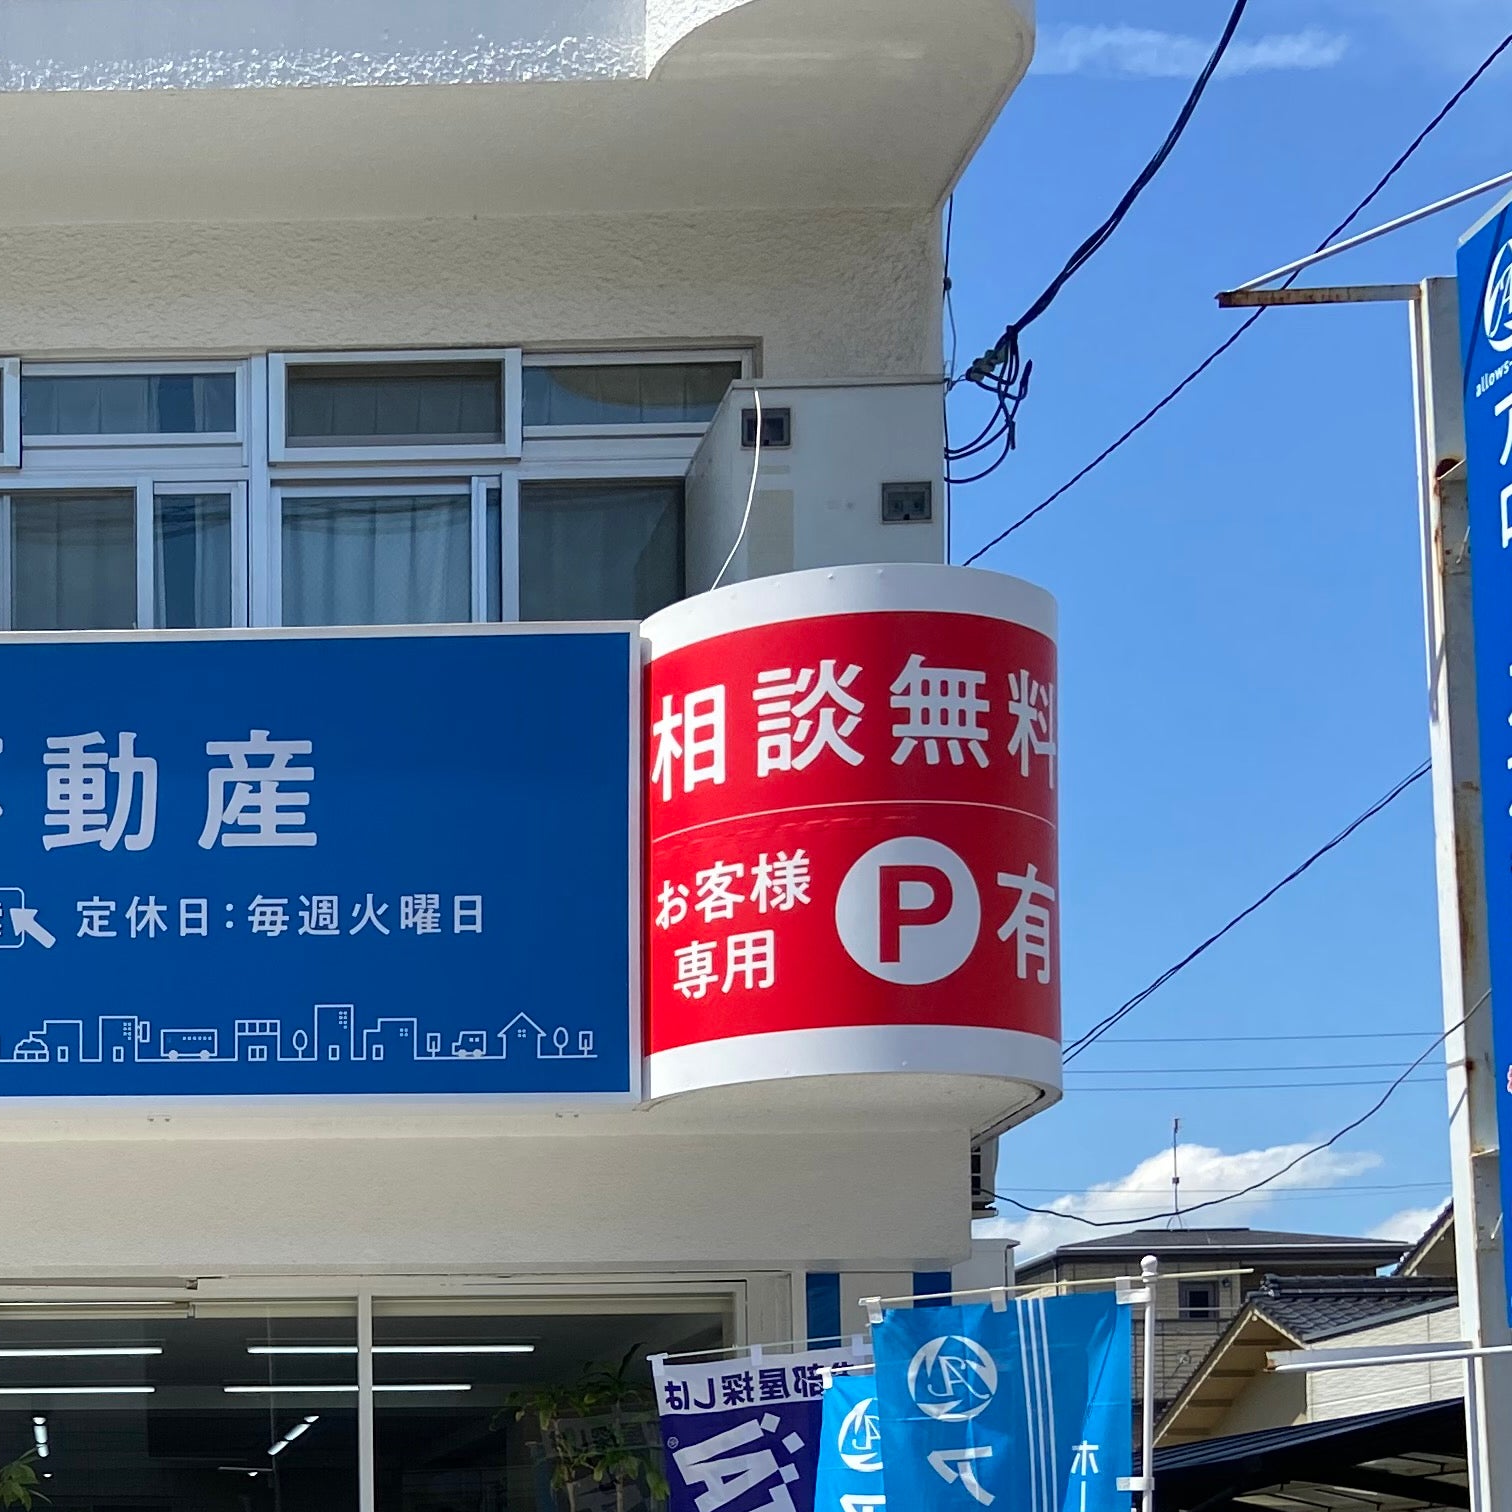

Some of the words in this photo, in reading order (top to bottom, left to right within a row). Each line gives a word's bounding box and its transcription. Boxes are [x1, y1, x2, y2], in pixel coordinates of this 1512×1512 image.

[651, 653, 1056, 801] 相談無料
[76, 894, 485, 940] 定休日：毎週火曜日
[655, 848, 812, 930] お客様
[879, 864, 953, 964] P
[996, 863, 1056, 985] 有
[673, 929, 776, 1000] 専用
